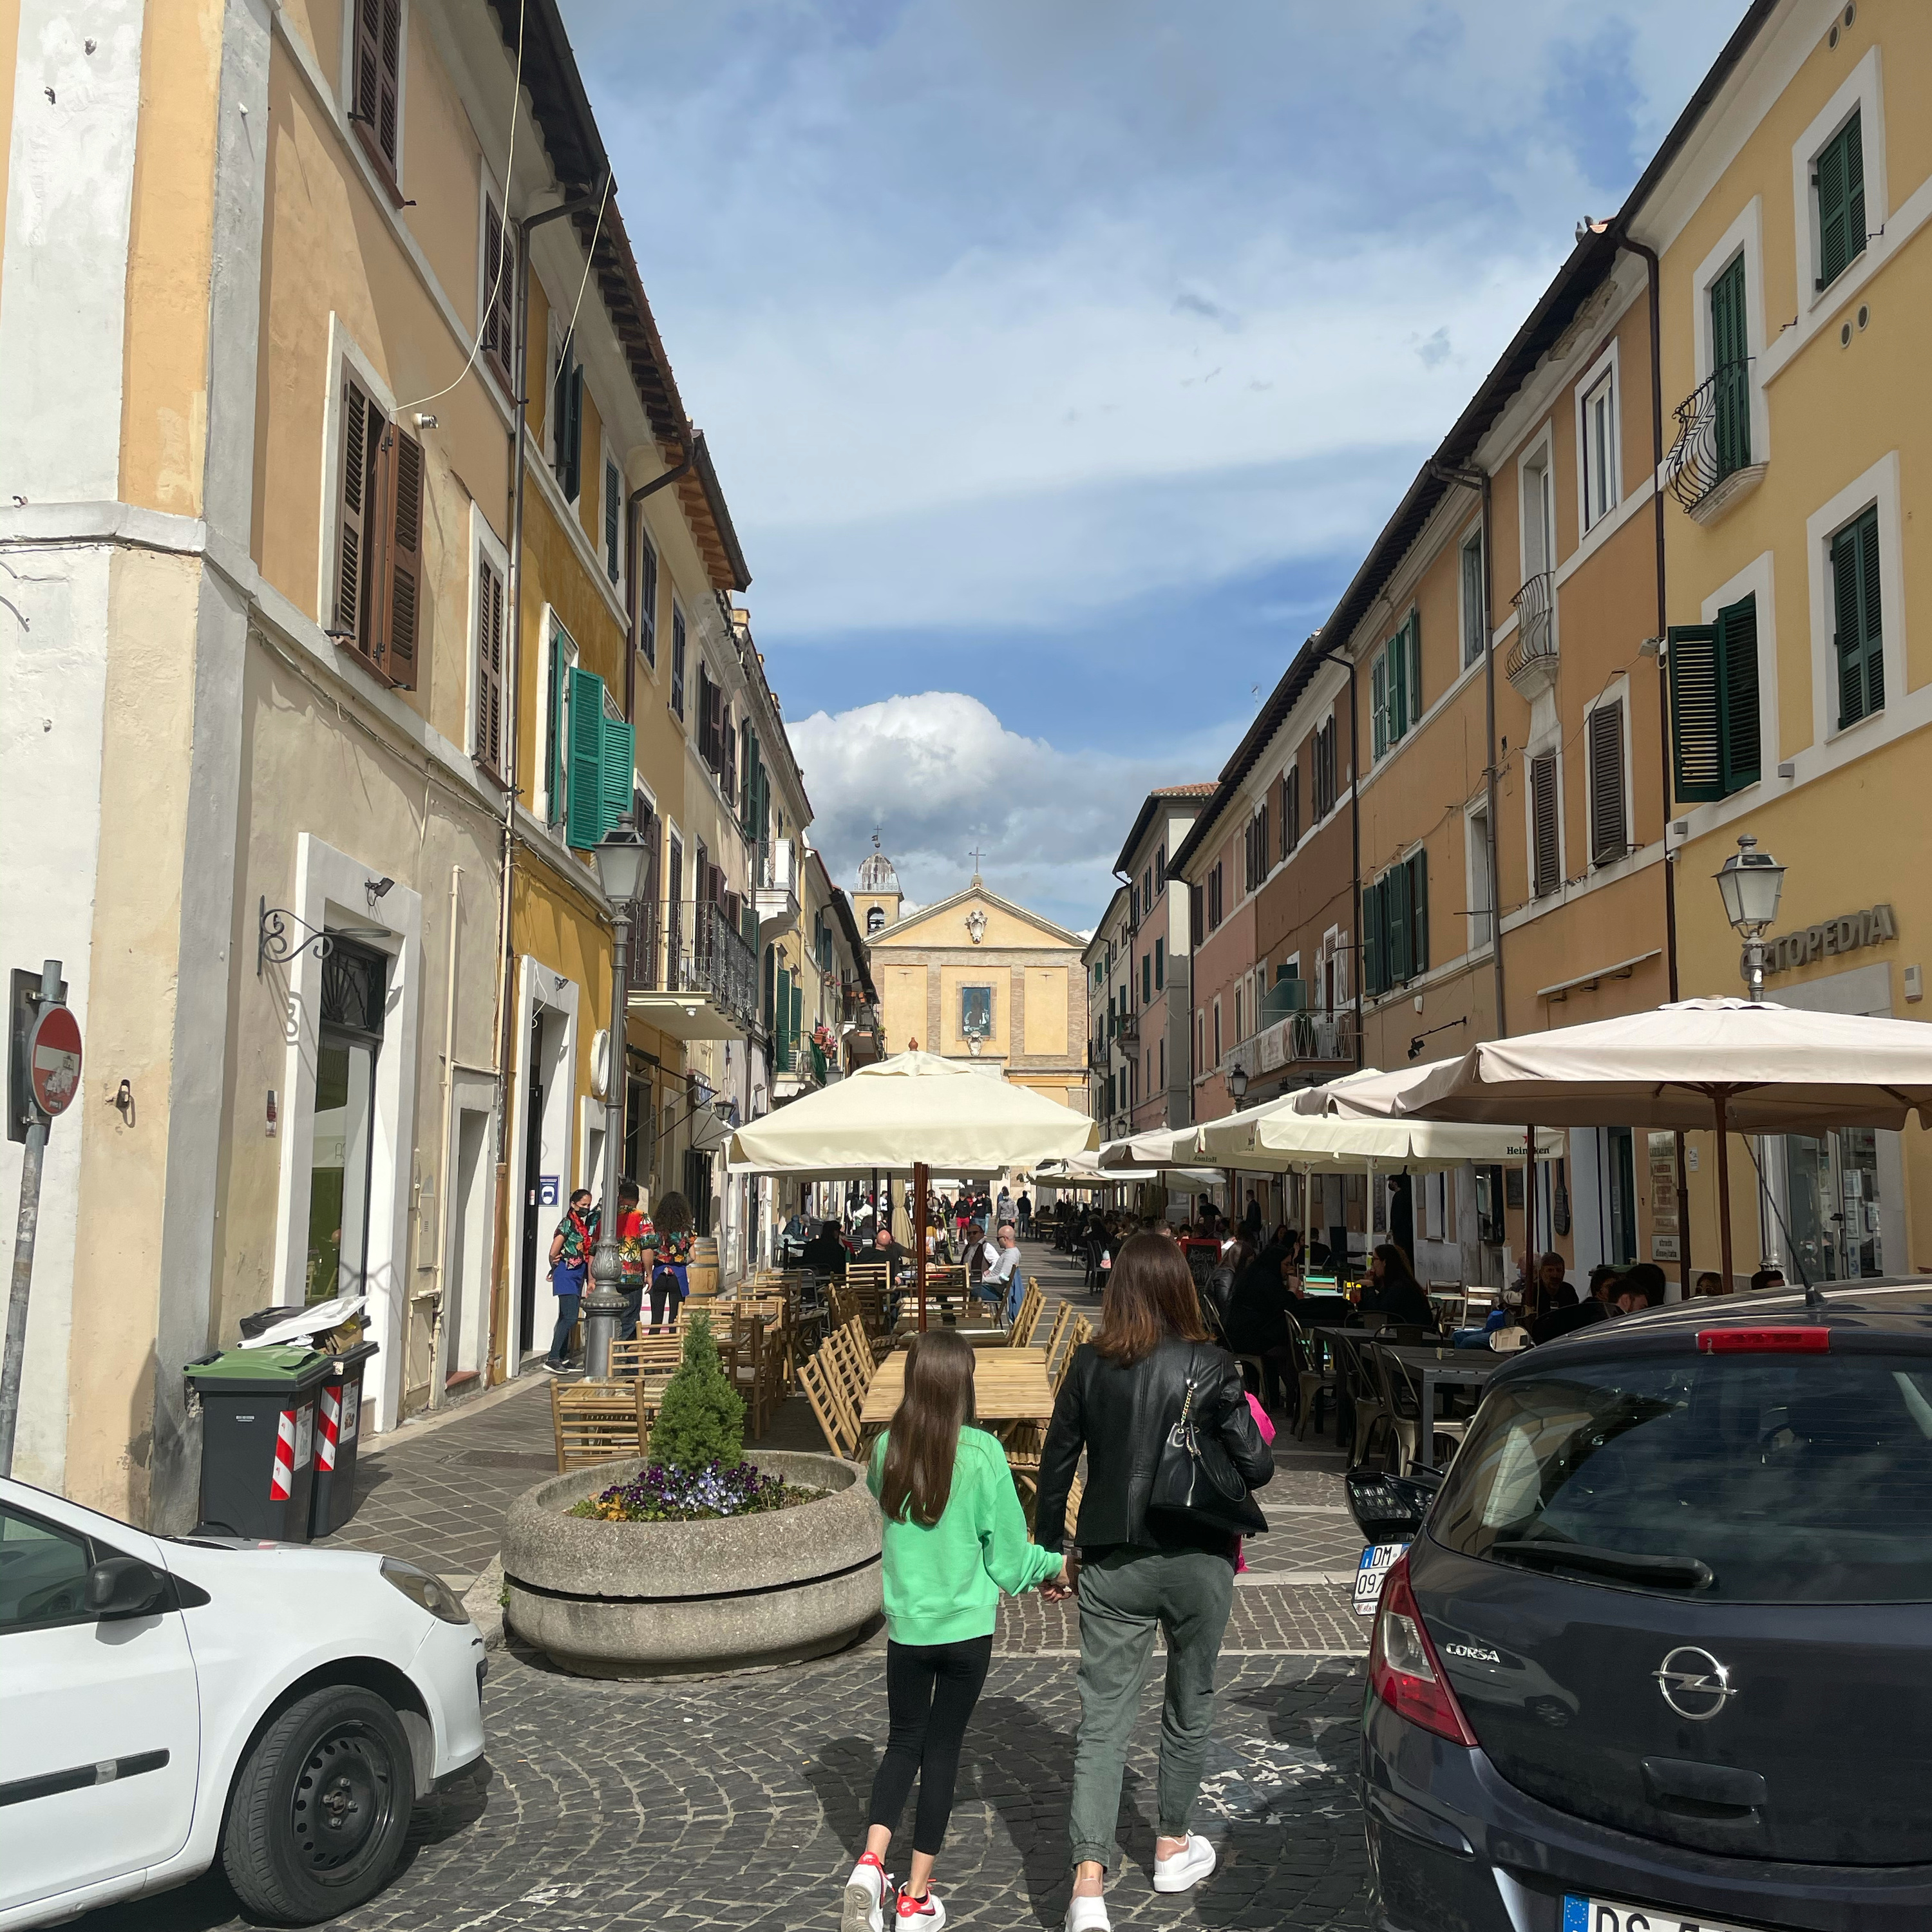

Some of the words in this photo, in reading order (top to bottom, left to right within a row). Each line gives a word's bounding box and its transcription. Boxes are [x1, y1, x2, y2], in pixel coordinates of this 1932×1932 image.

[1506, 1146, 1549, 1155] Heinken
[1372, 1546, 1392, 1567] DM
[1446, 1643, 1501, 1663] CORSA
